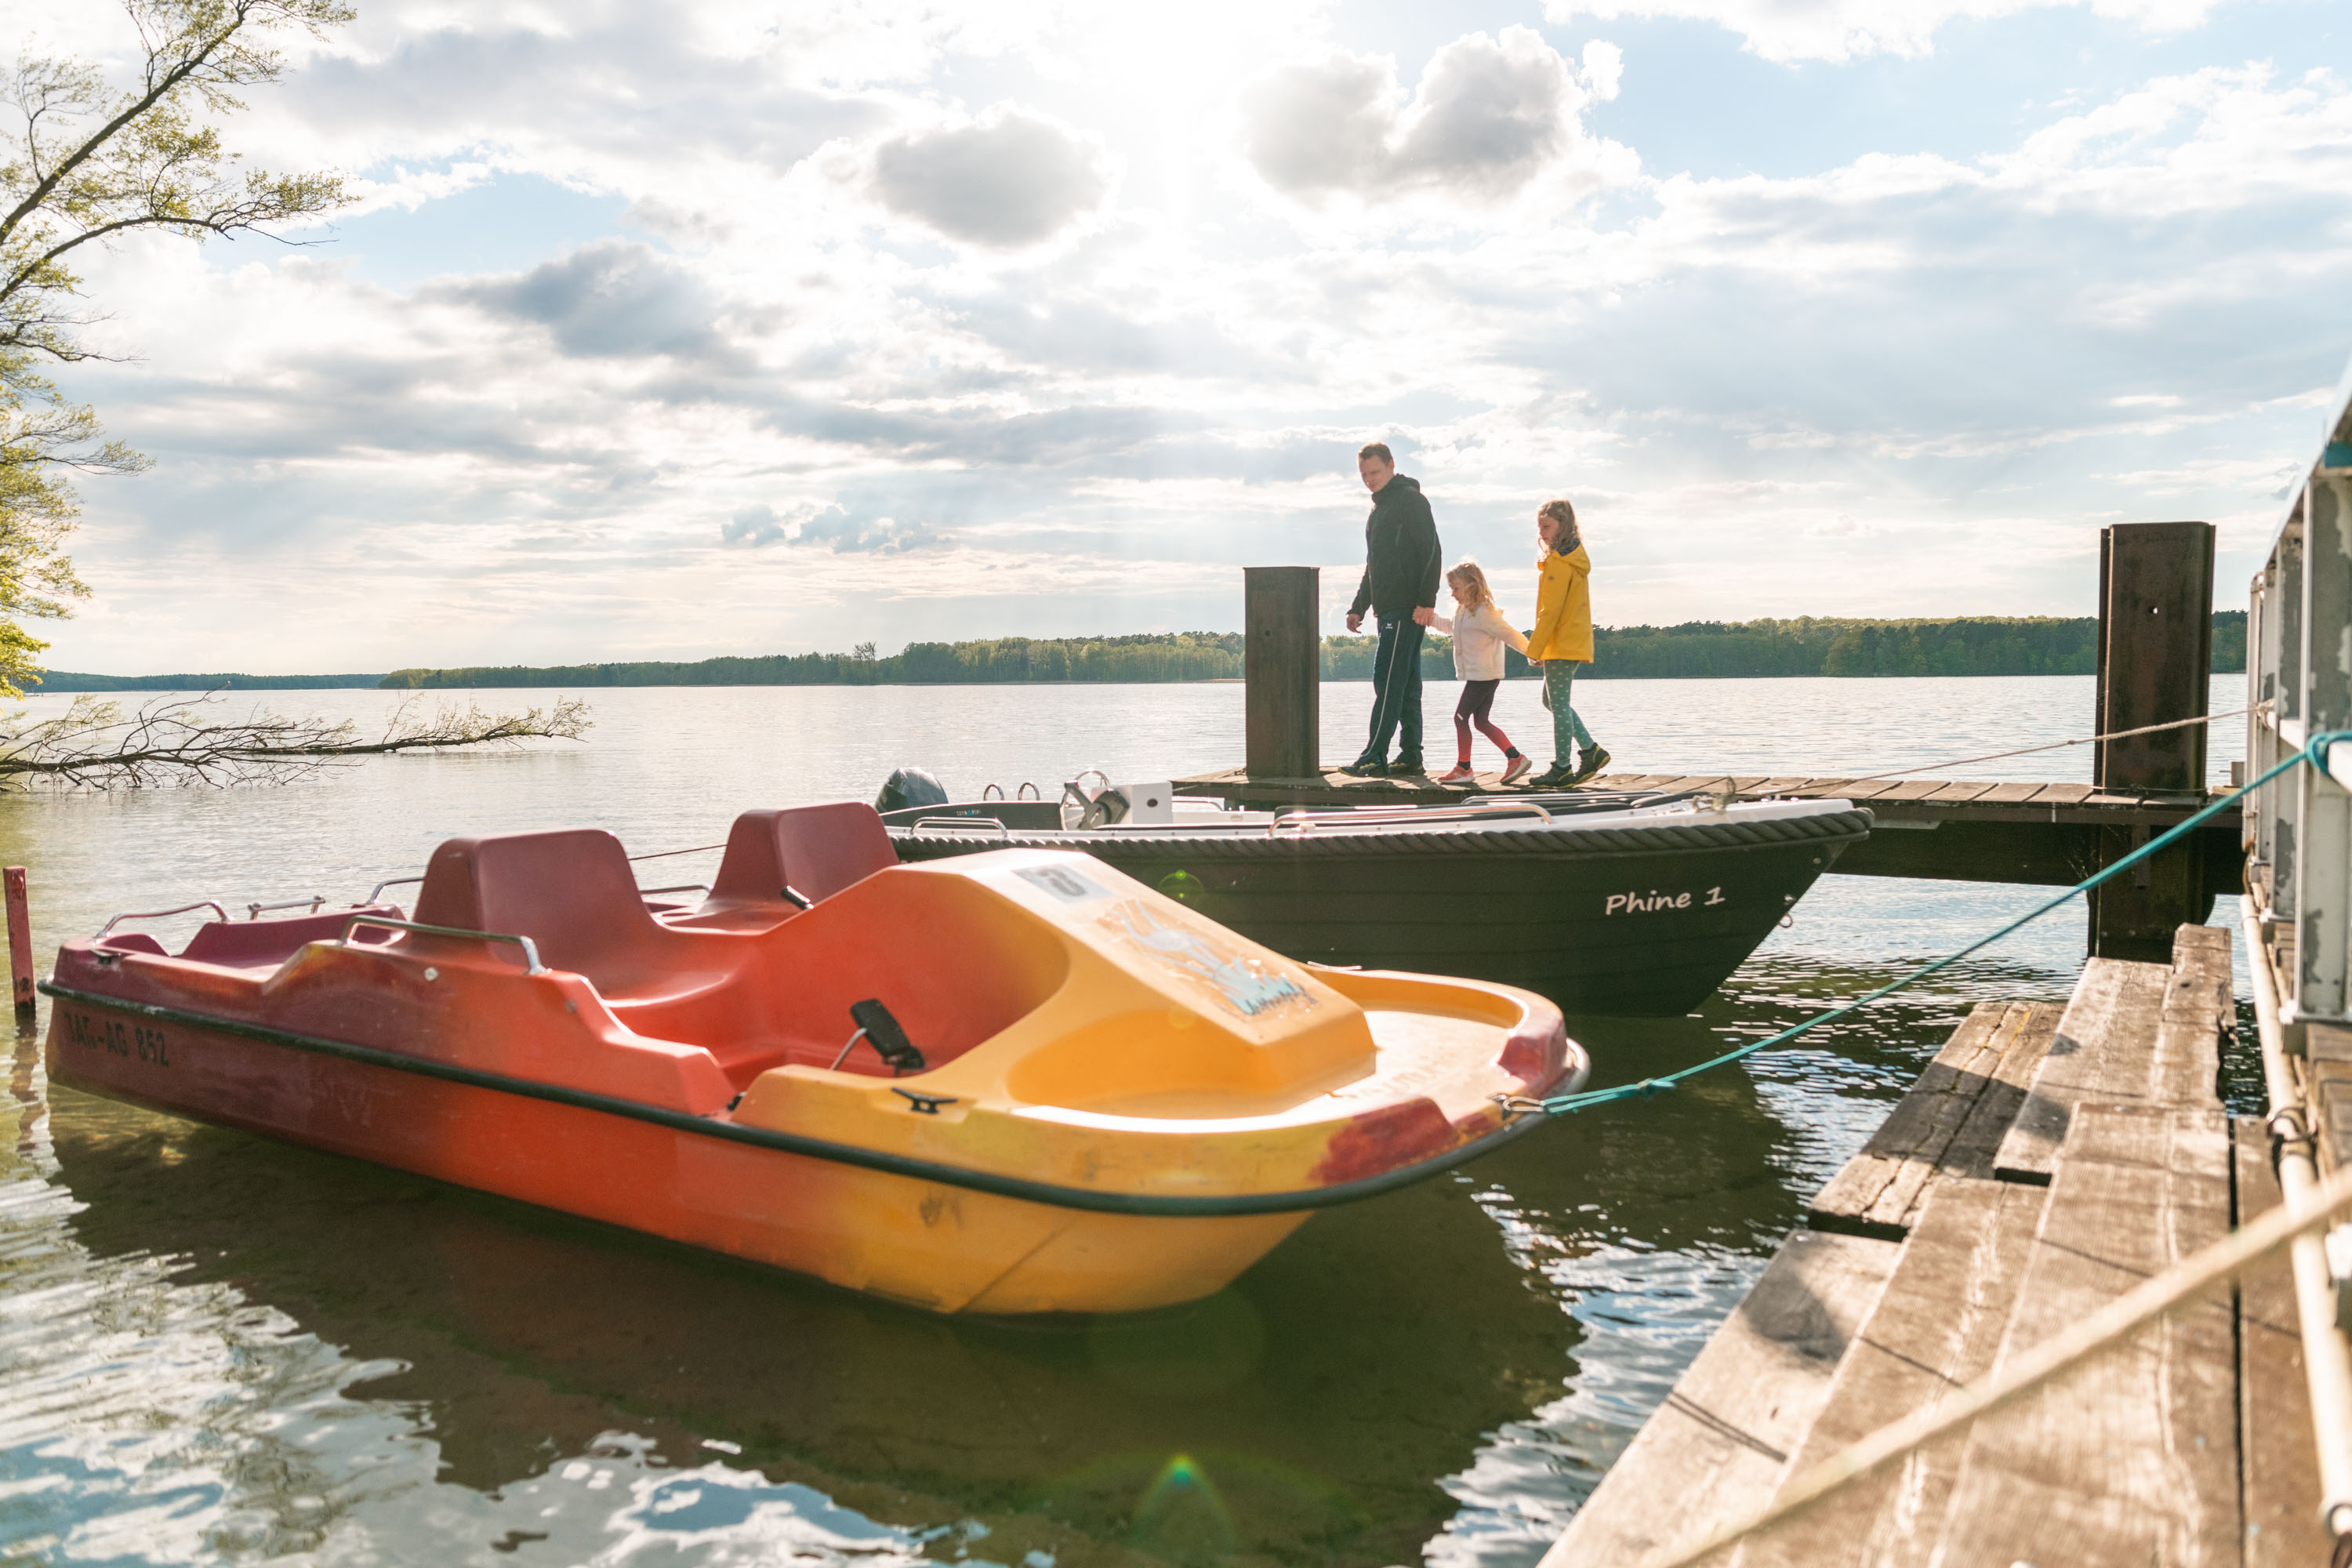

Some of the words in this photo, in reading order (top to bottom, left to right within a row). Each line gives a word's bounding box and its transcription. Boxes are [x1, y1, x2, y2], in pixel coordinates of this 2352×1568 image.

[1605, 889, 1692, 916] Phine
[1703, 886, 1726, 906] 1
[135, 1026, 169, 1067] 852
